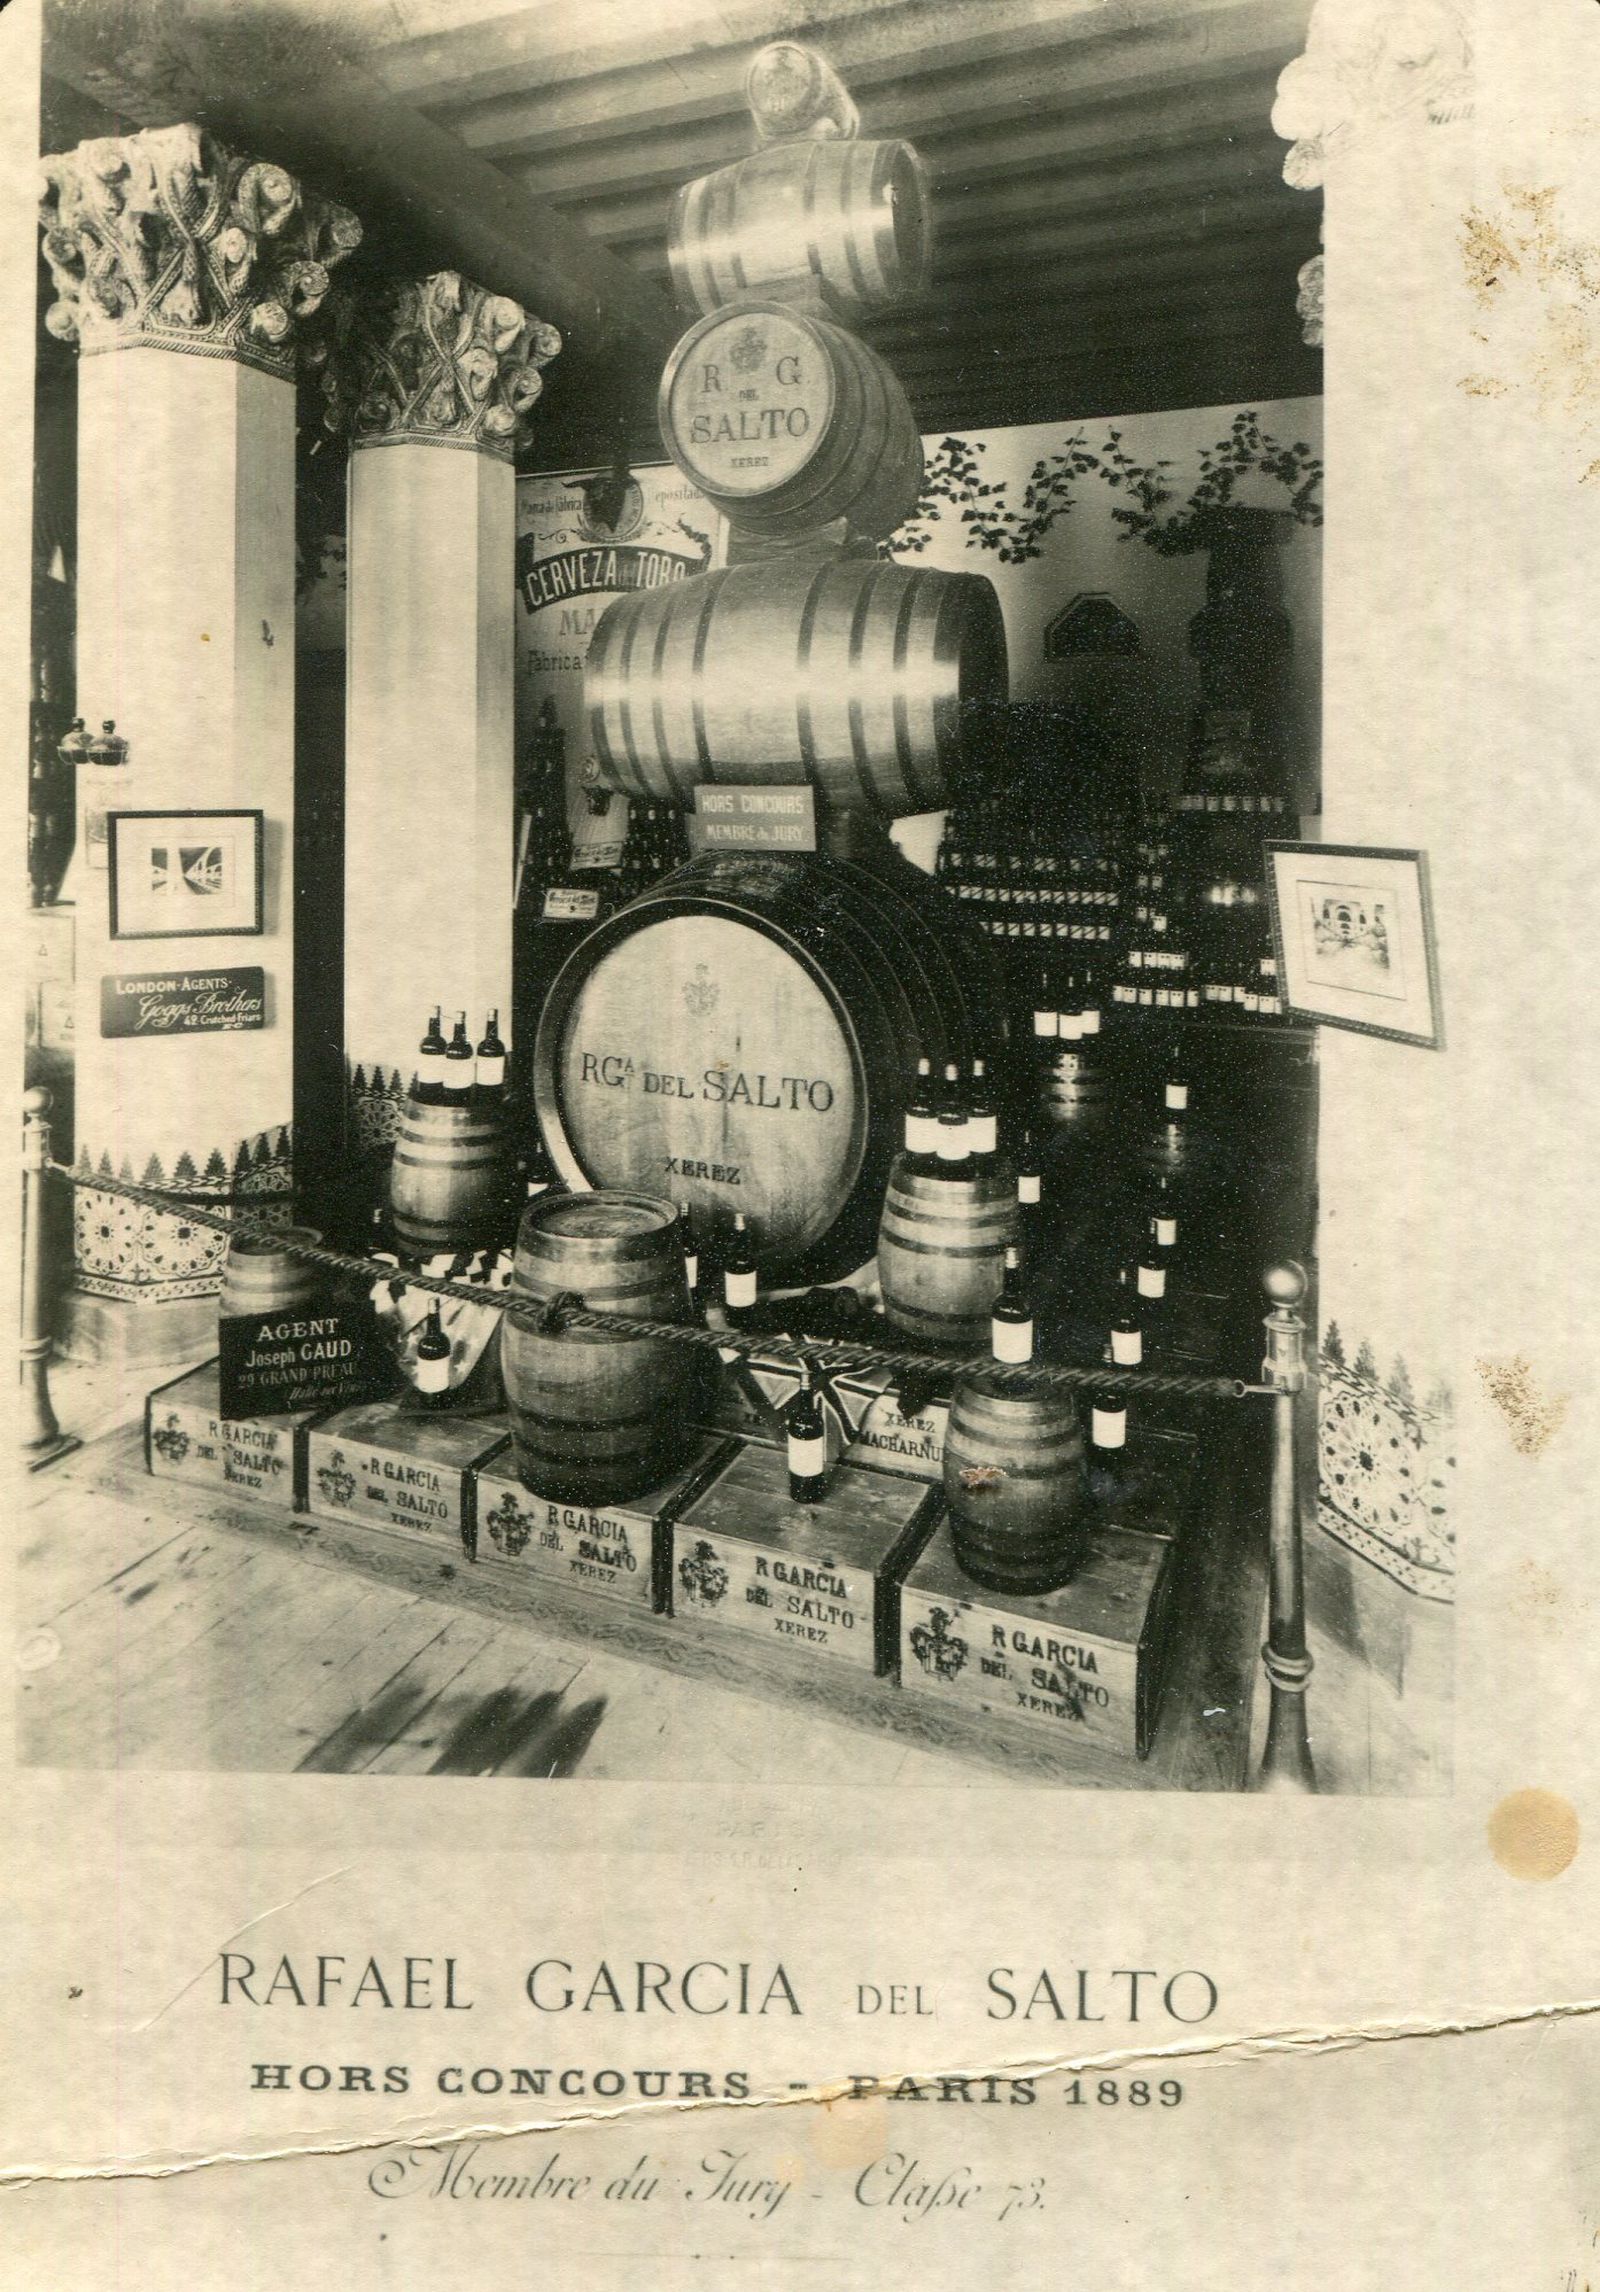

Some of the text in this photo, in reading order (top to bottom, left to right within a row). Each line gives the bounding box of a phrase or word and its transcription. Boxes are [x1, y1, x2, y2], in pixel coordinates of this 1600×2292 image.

[701, 356, 802, 393] R G
[690, 407, 809, 443] SALTO
[526, 550, 617, 606] CERVEZA
[636, 551, 687, 589] TORO
[702, 794, 804, 816] HORS CONCOURS
[705, 824, 756, 842] MEMBRE
[773, 825, 804, 843] JURY
[116, 977, 229, 995] LONDON AGENTS
[642, 1072, 694, 1099] DEL
[703, 1070, 834, 1112] SALTO
[665, 1156, 741, 1185] XEREZ
[256, 1318, 340, 1343] AGENT
[244, 1339, 352, 1369] Joseph GAUD
[259, 1367, 308, 1387] GRAND
[209, 1420, 278, 1451] R GARCIA
[884, 1412, 936, 1434] XEREZ
[197, 1445, 283, 1476] DEL SALTO
[371, 1457, 440, 1492] R GARCIA
[367, 1486, 448, 1519] DEL SALTO
[391, 1512, 432, 1533] XEREZ
[547, 1504, 627, 1544] R GARCIA
[539, 1530, 637, 1573] DEL SALTO
[569, 1559, 616, 1584] XEREZ
[756, 1556, 848, 1599] R GARCIA
[746, 1587, 854, 1630] DEL SALTO
[774, 1618, 829, 1644] XEREZ
[992, 1624, 1098, 1674] R GARCIA
[980, 1656, 1110, 1708] DEL SALTO
[1016, 1691, 1085, 1722] XEREZ
